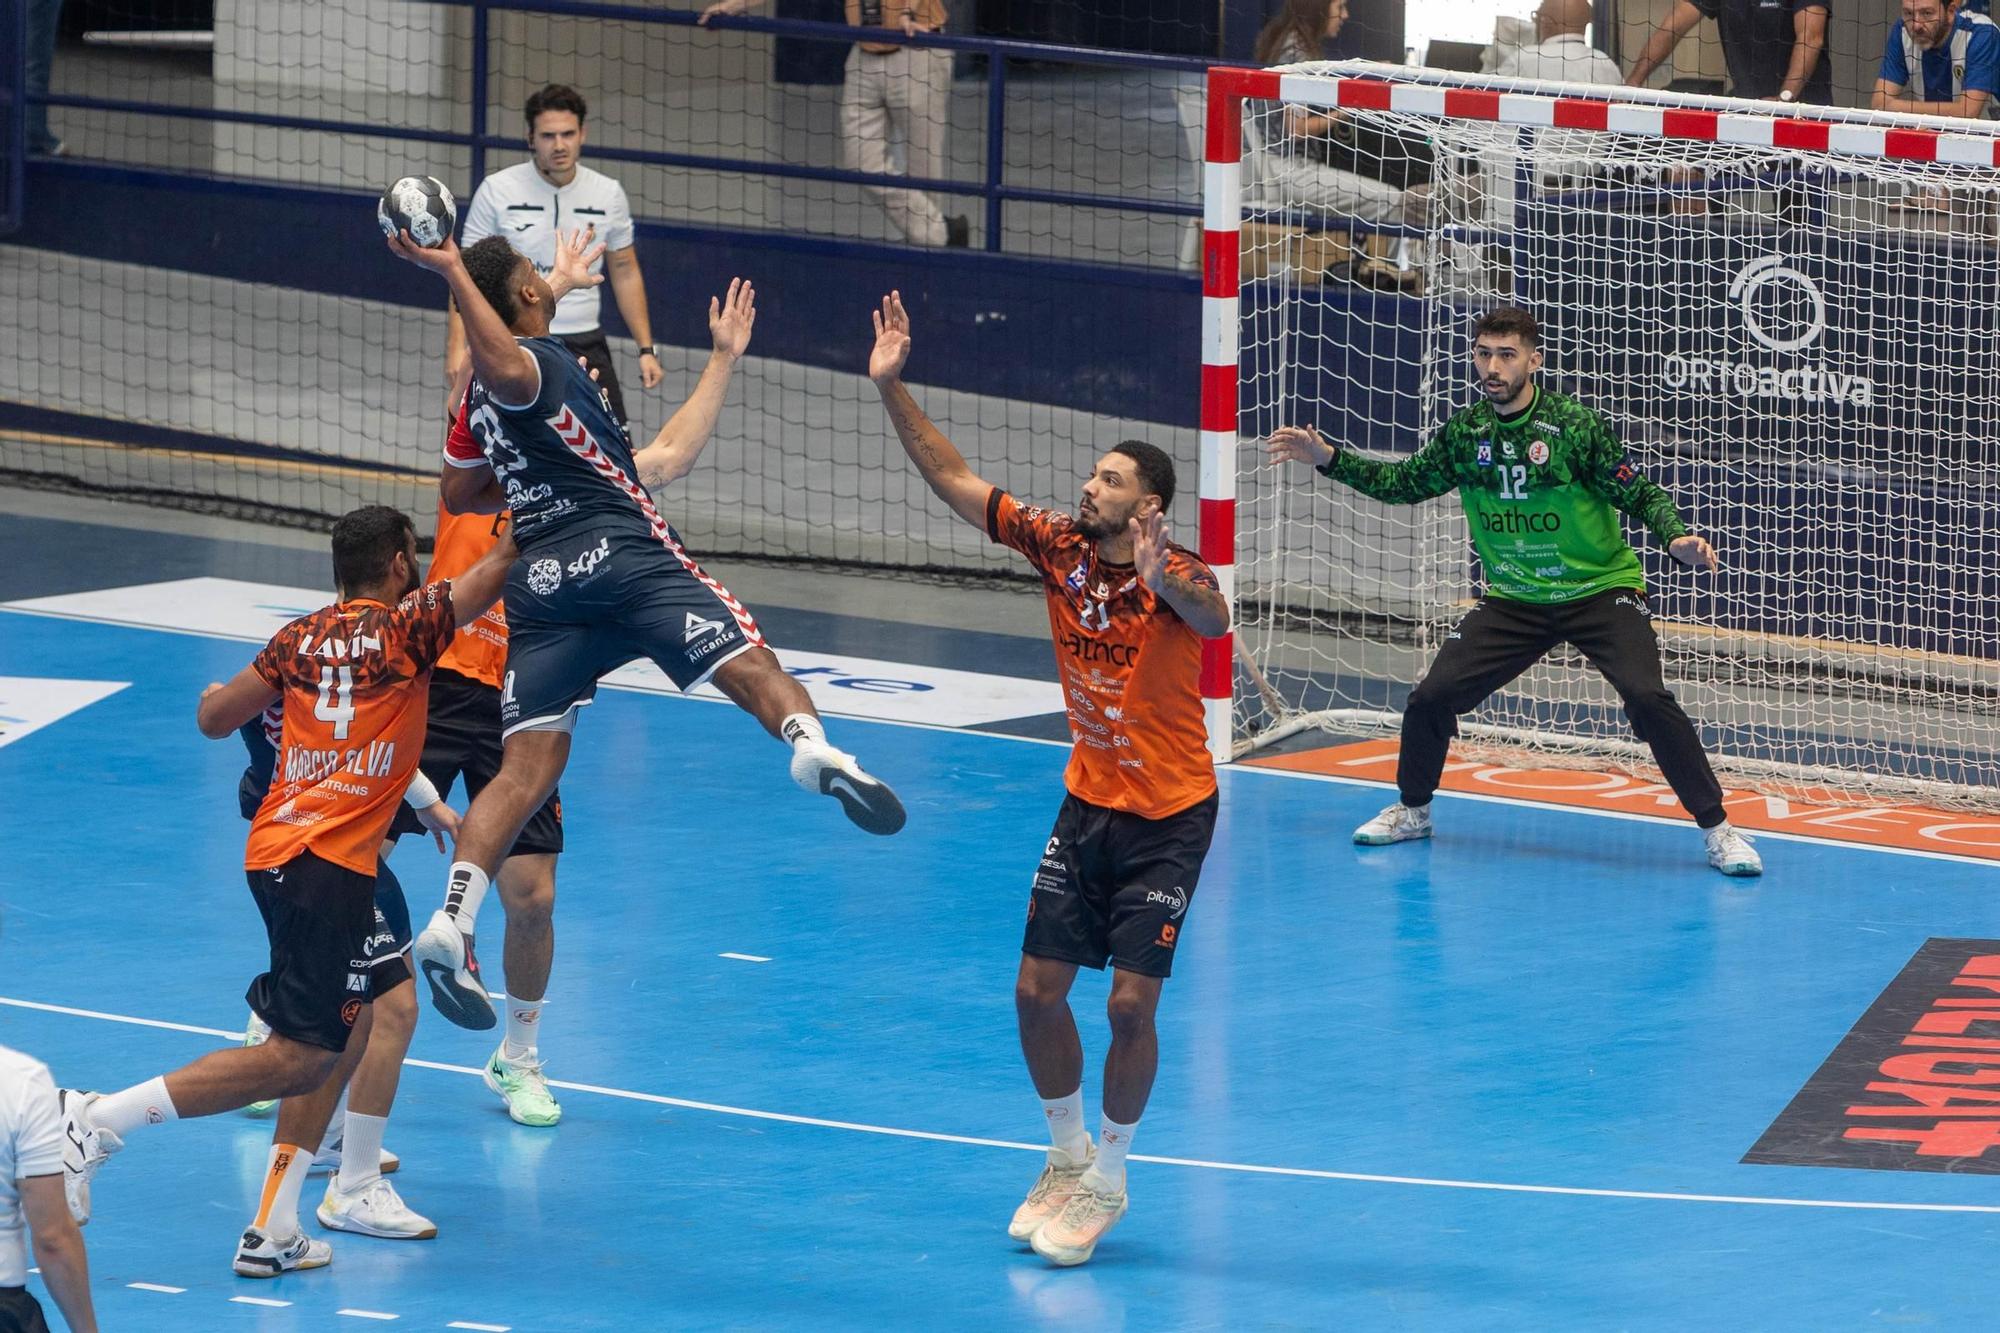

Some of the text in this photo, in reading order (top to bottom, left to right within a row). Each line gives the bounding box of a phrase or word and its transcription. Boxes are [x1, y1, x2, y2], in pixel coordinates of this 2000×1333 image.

[1663, 355, 1872, 408] ORTOactiva
[1498, 464, 1528, 499] 12
[1478, 506, 1560, 534] bathco
[1080, 599, 1111, 632] 21
[313, 665, 356, 741] 4
